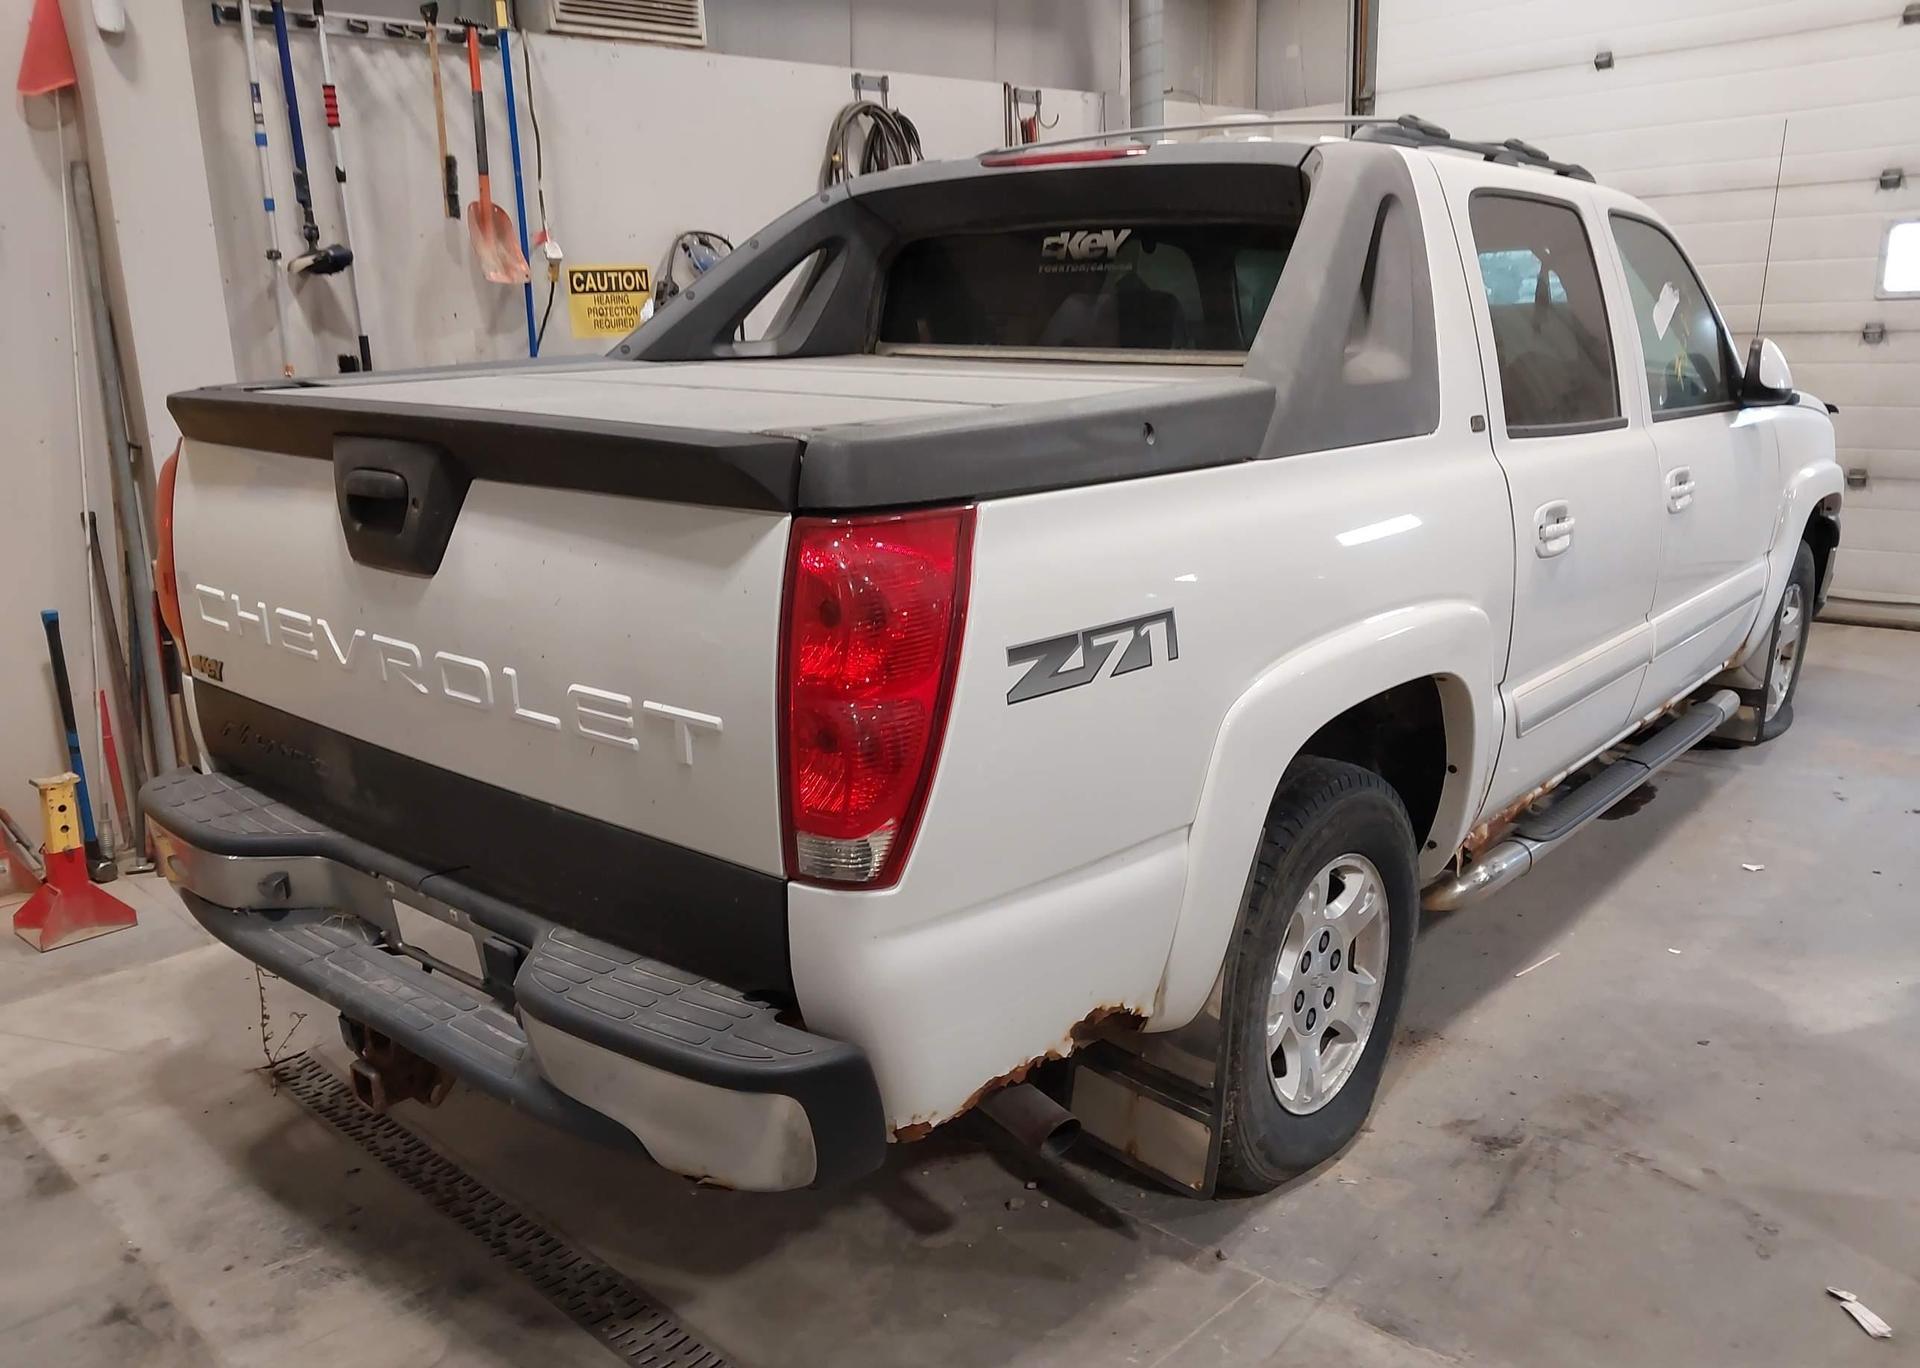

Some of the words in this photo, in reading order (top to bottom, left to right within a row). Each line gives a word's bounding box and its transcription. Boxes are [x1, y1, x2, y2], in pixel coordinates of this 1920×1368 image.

[572, 271, 648, 293] CAUTION
[593, 294, 630, 306] HEARING
[586, 306, 639, 318] PROTECTION
[593, 318, 635, 330] REQUIRED
[1005, 606, 1179, 706] Z71
[195, 583, 724, 768] CHEVROLET
